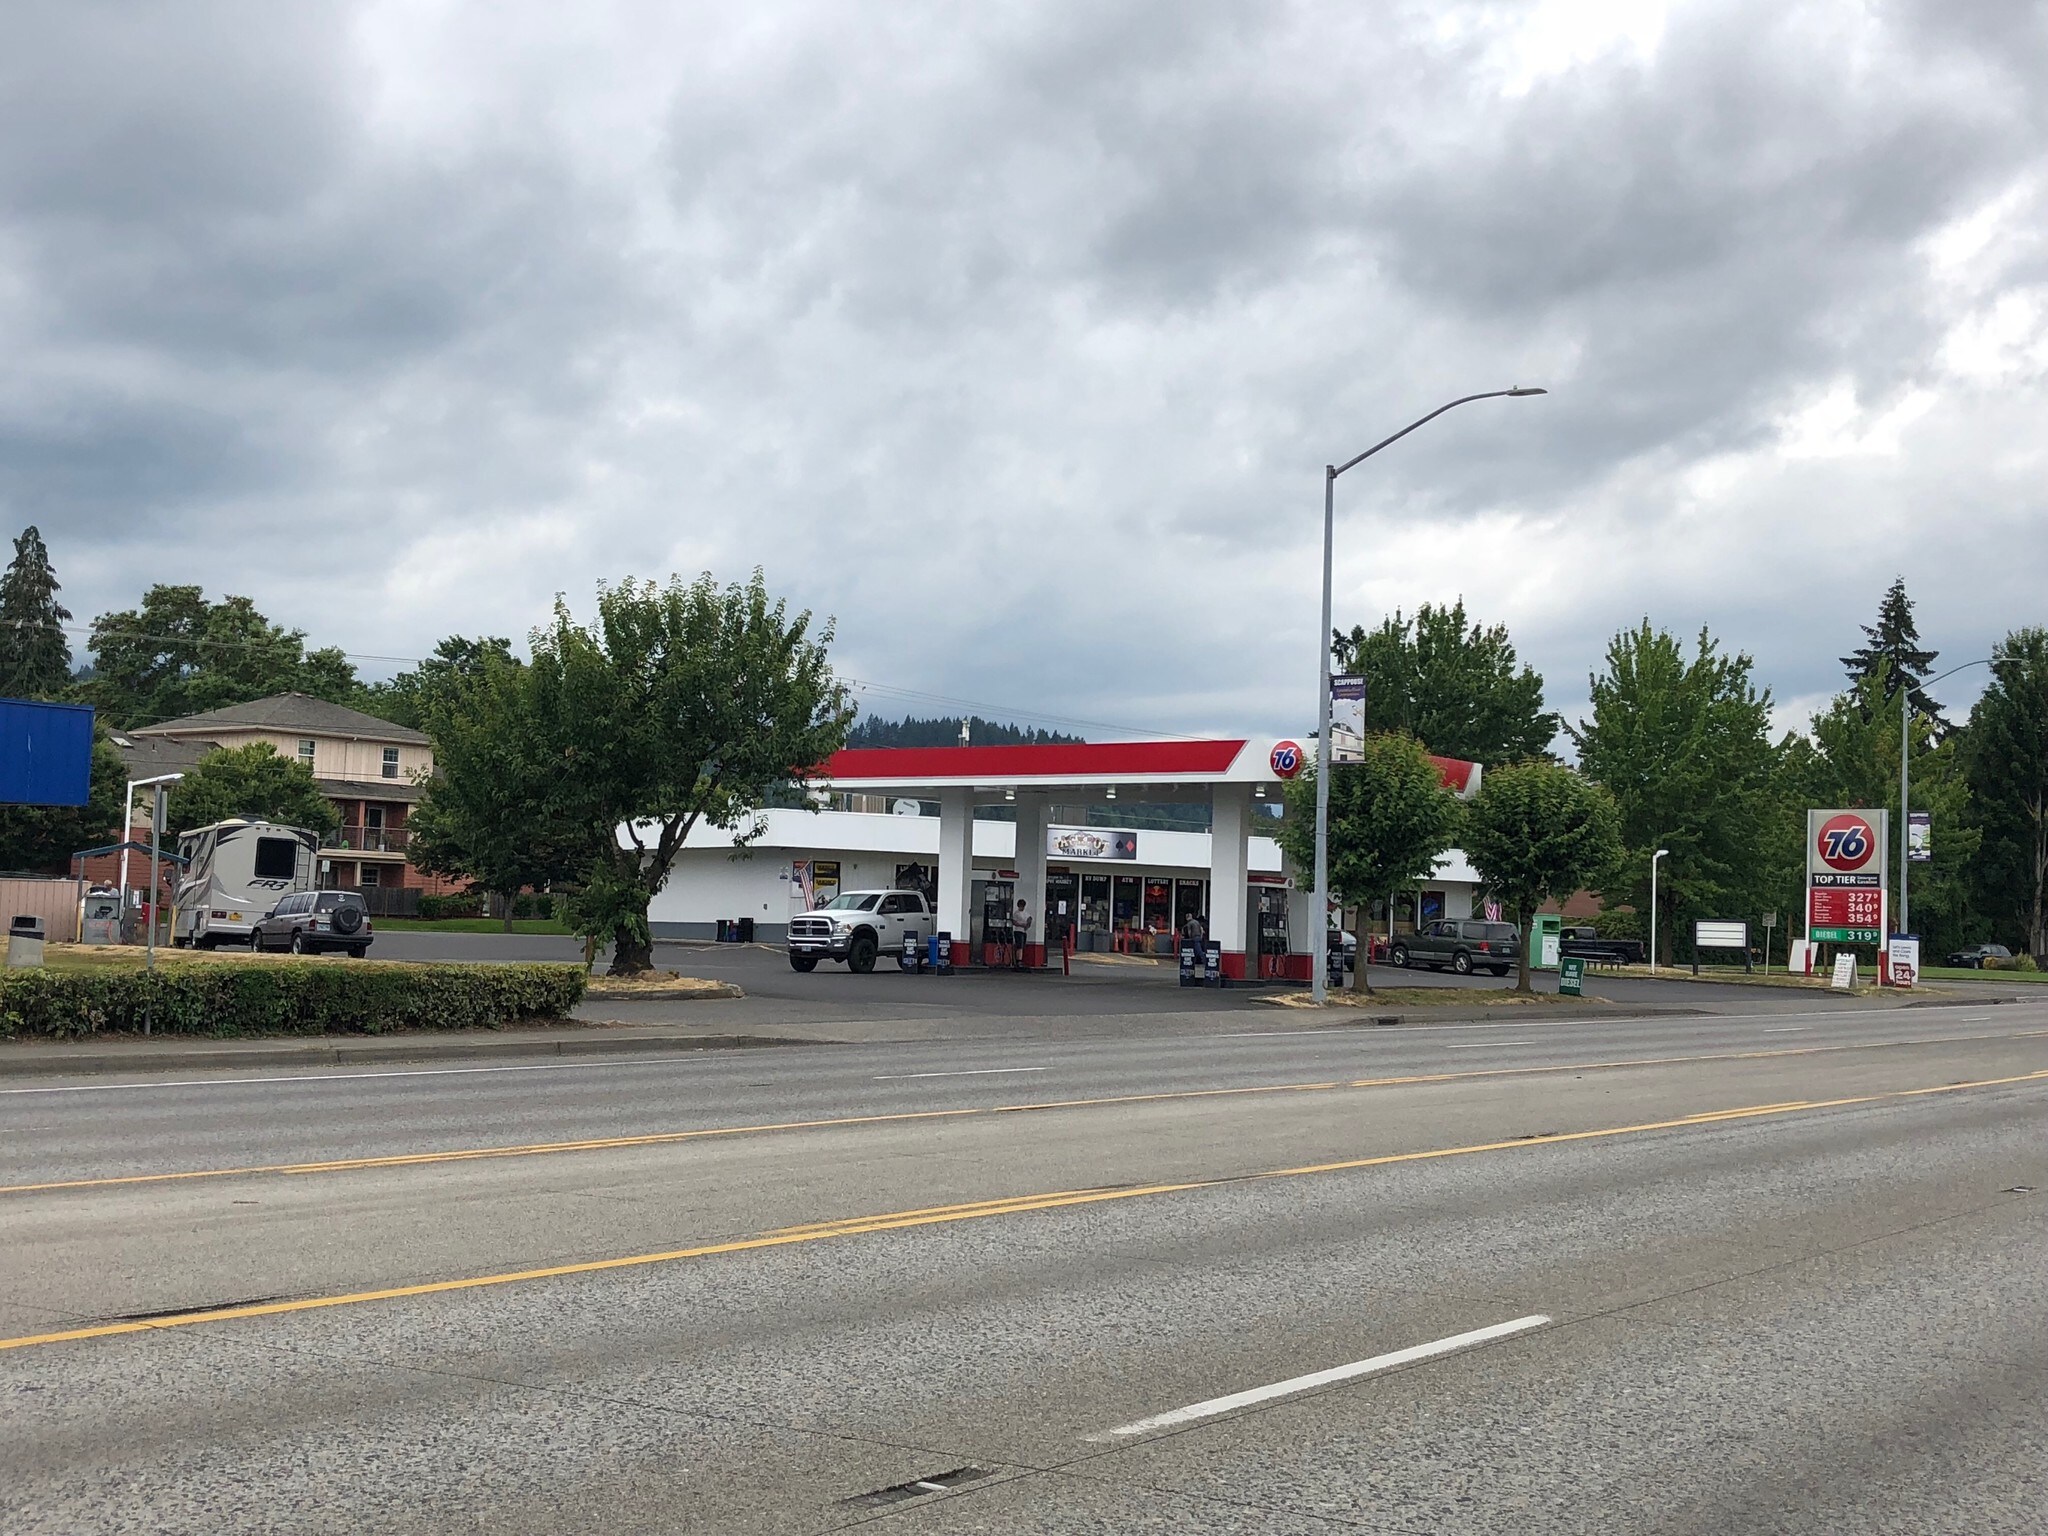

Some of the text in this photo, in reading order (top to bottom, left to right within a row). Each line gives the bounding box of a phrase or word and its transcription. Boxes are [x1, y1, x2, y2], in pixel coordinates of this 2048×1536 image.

[1273, 747, 1297, 770] 76
[1823, 826, 1867, 860] 76
[1814, 875, 1834, 884] TOP
[1835, 875, 1856, 884] TIER
[246, 879, 289, 891] FR3
[1815, 931, 1838, 939] DIESEL
[1895, 970, 1911, 980] 24
[1560, 977, 1580, 987] DIESEL
